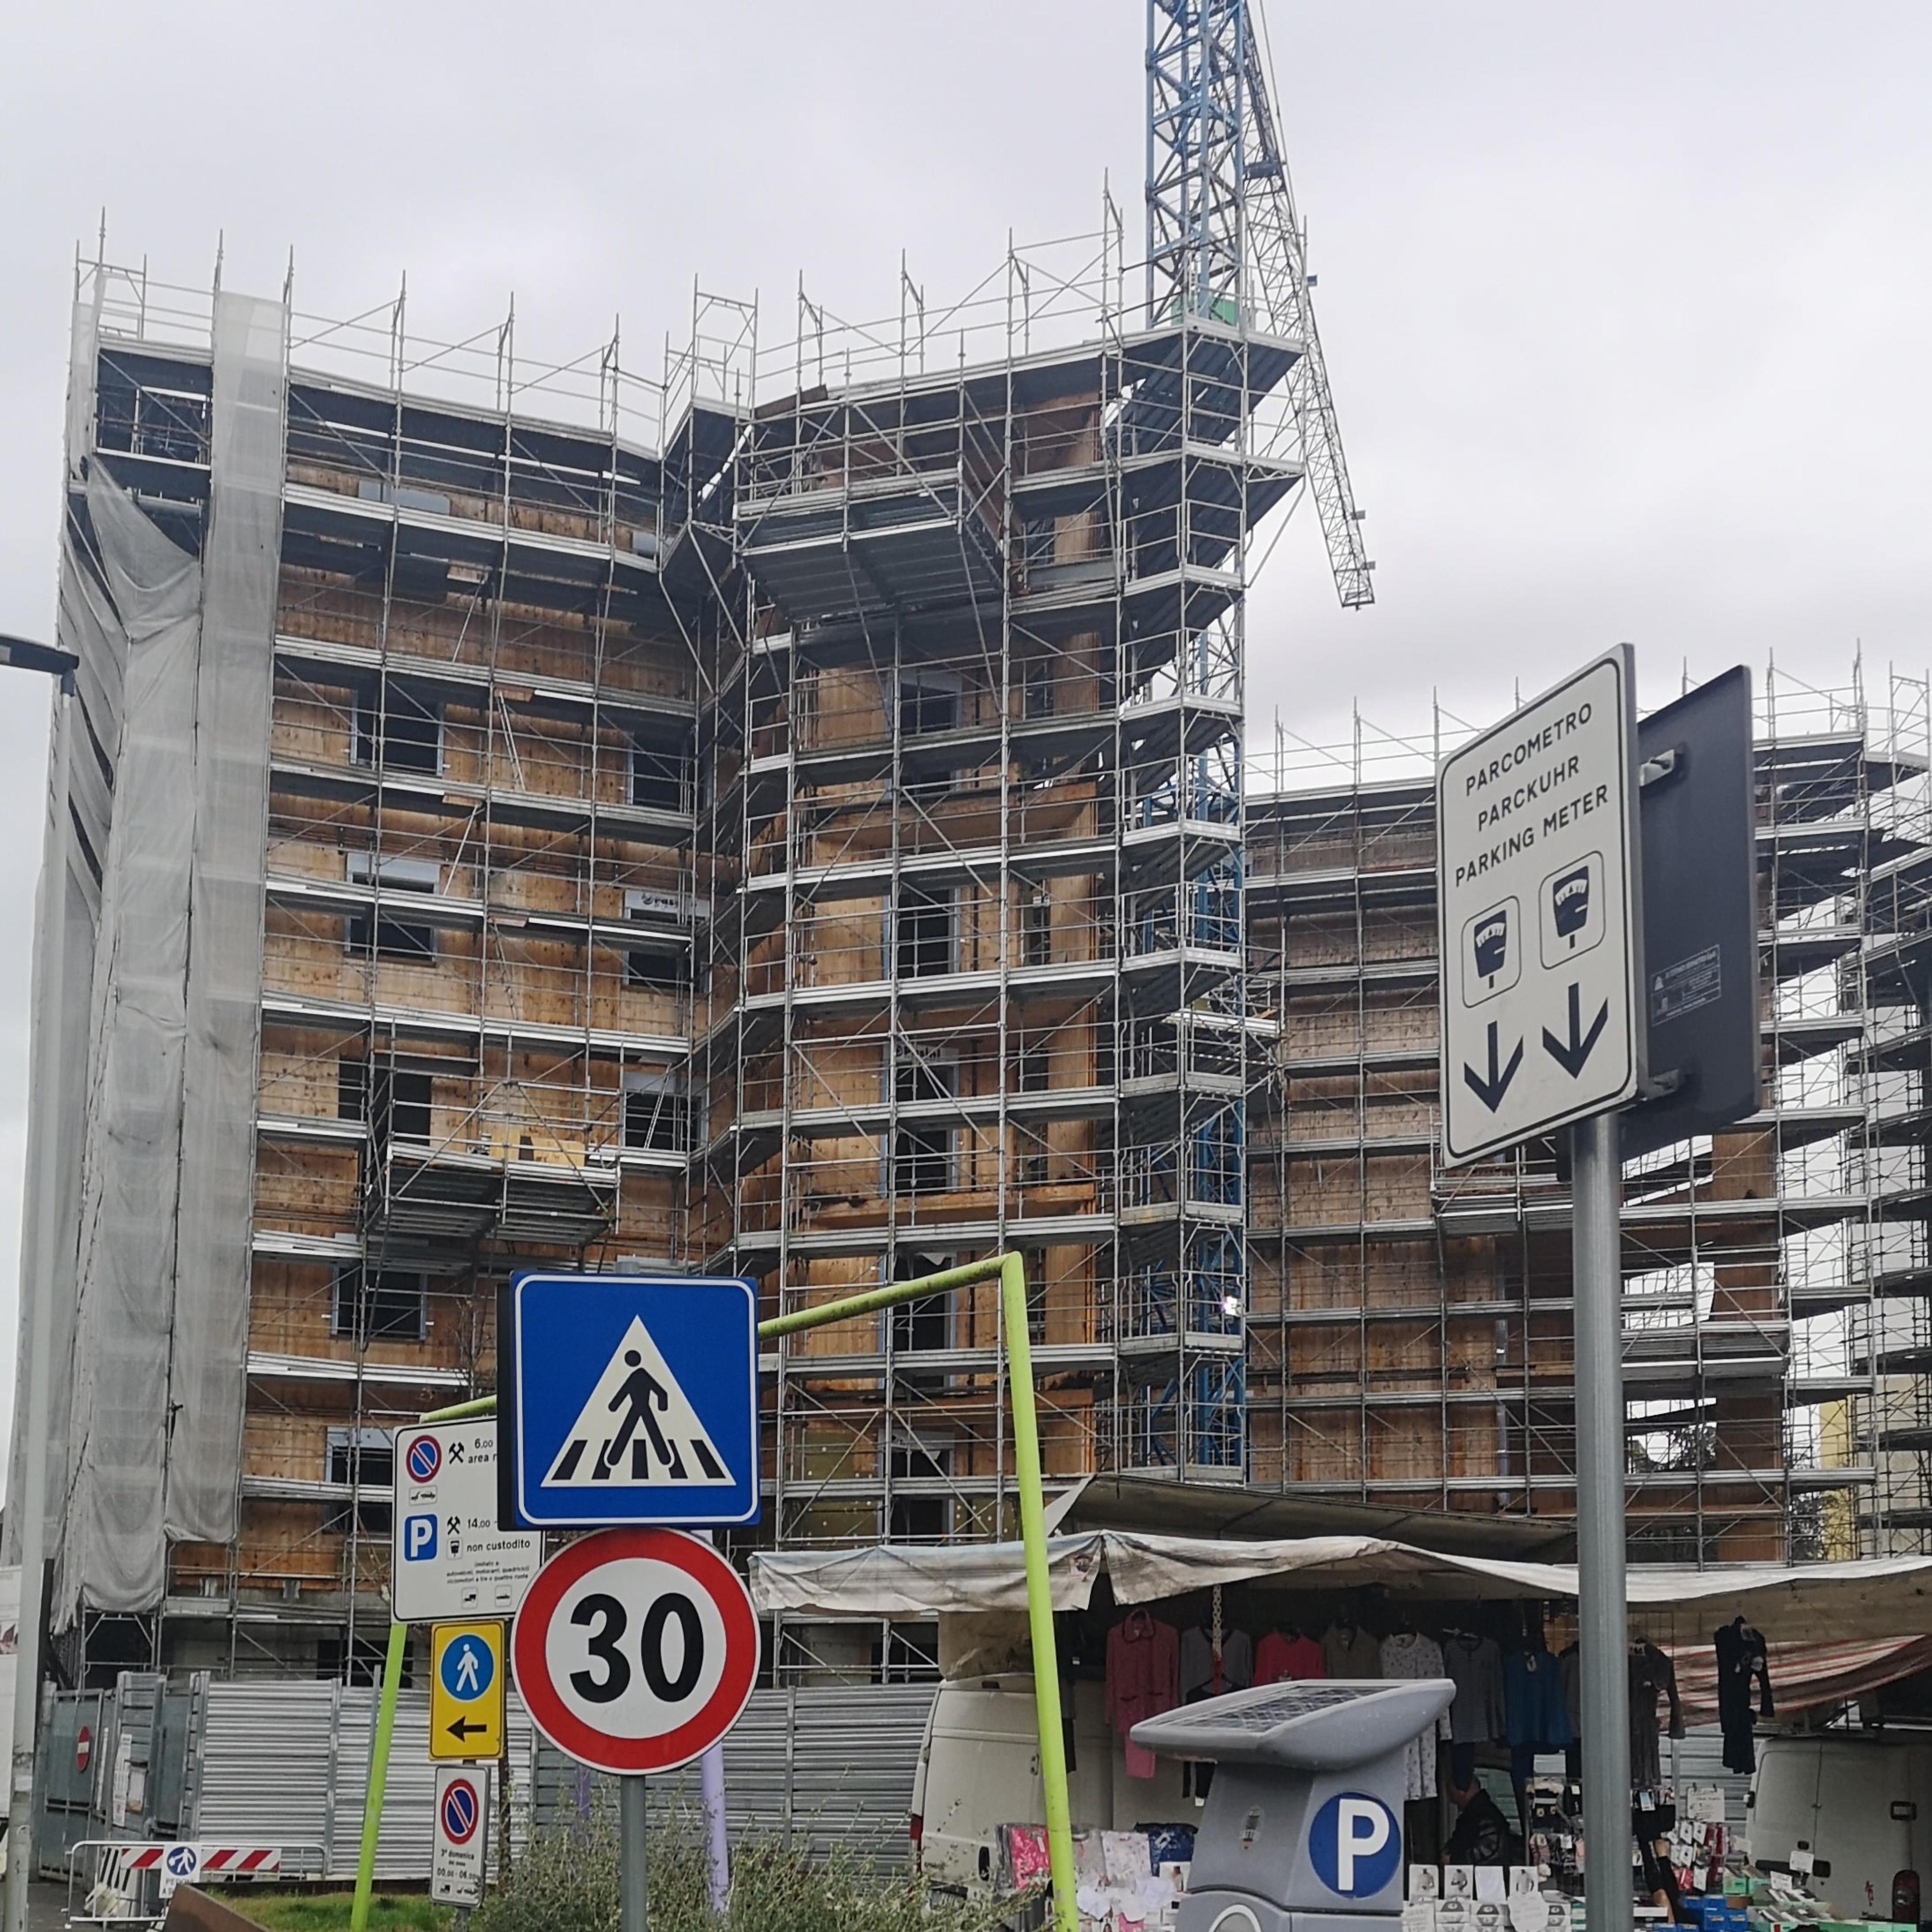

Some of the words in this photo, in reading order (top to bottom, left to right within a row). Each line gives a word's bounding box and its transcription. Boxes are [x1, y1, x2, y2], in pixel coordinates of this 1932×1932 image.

[1466, 703, 1591, 796] PARCOMETRO
[1478, 756, 1579, 832] PARCKUHR
[1456, 827, 1534, 888] PARKING
[1543, 784, 1607, 837] METER
[468, 1454, 489, 1464] area
[474, 1438, 493, 1448] 6.00
[411, 1519, 432, 1558] P
[467, 1544, 482, 1552] non
[486, 1539, 530, 1551] custodito
[468, 1517, 490, 1528] 14.00
[570, 1592, 704, 1704] 30
[1338, 1798, 1390, 1891] P
